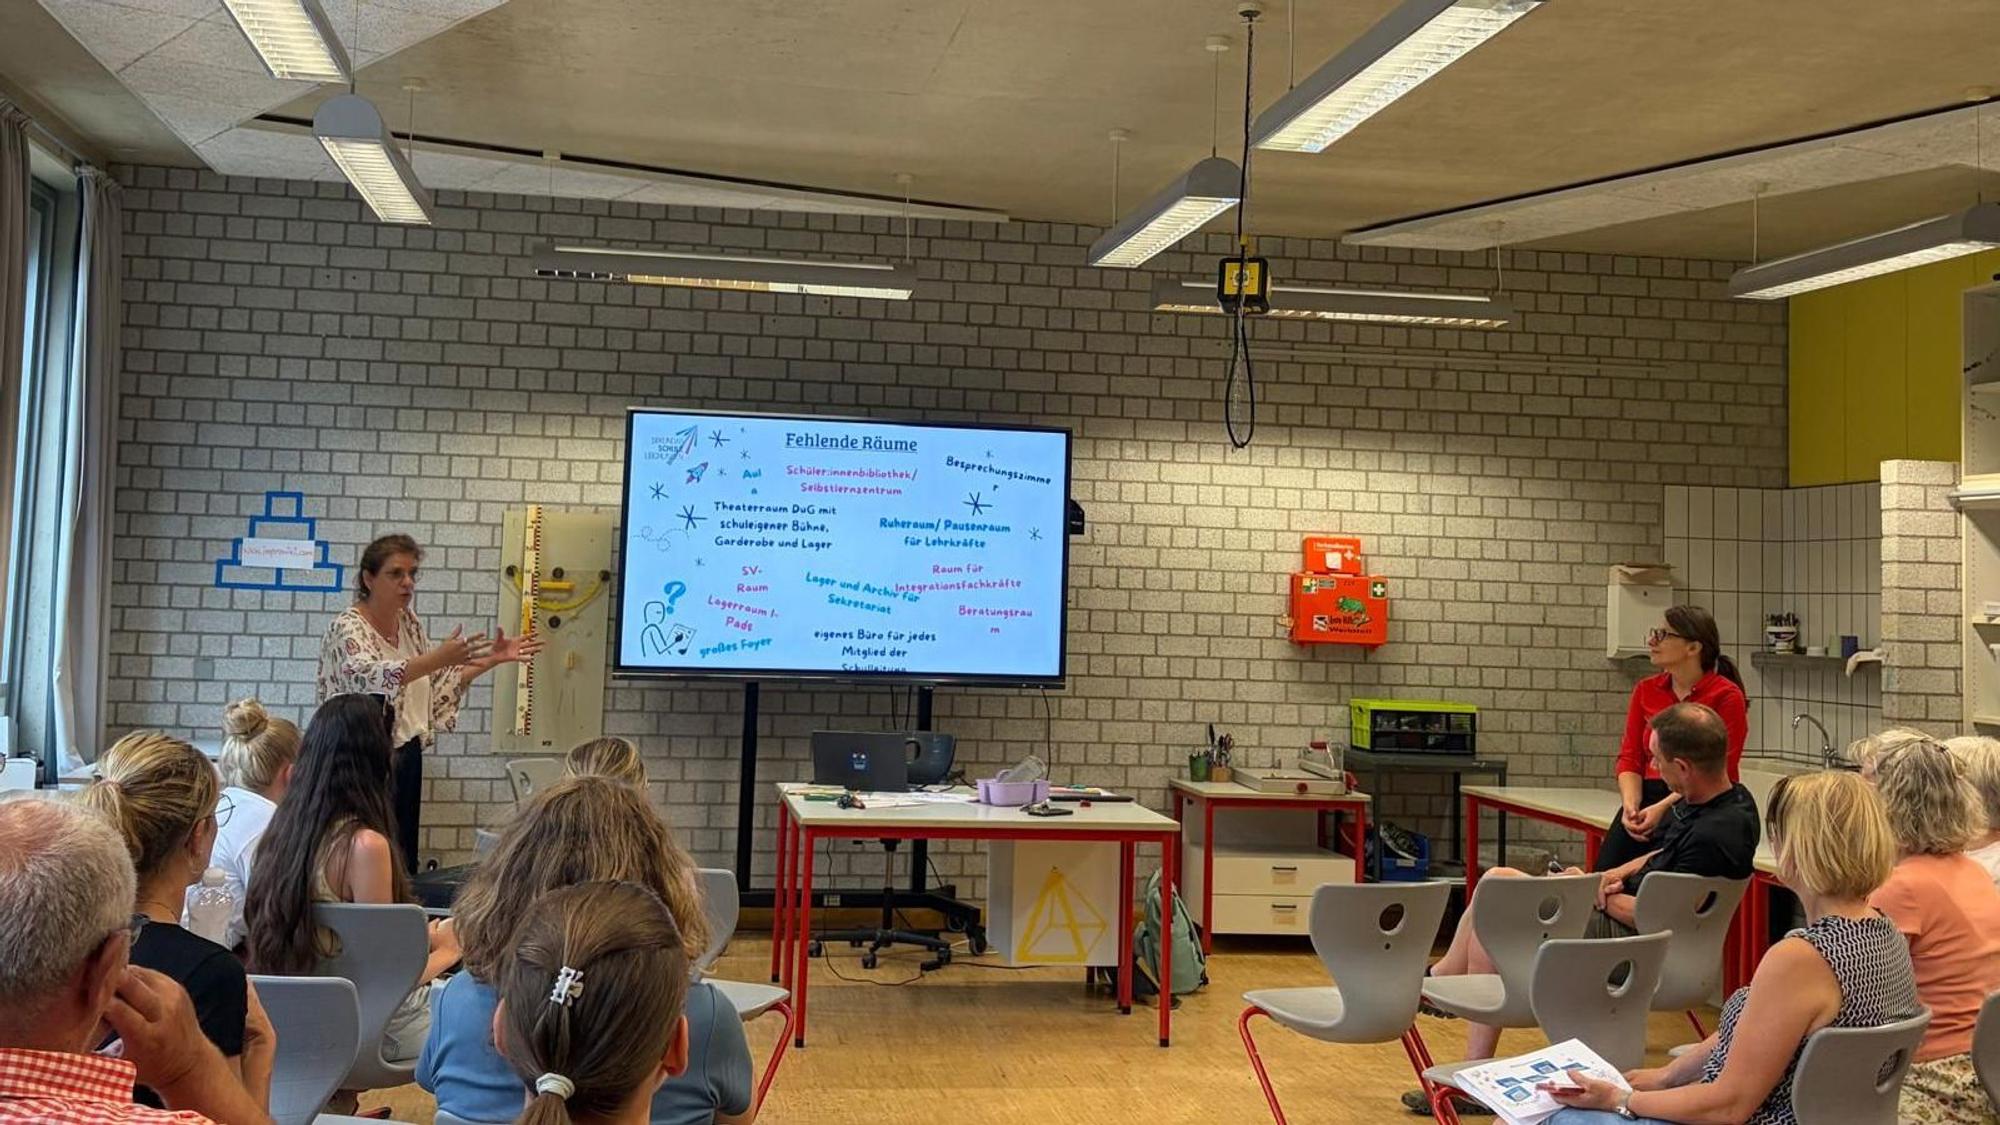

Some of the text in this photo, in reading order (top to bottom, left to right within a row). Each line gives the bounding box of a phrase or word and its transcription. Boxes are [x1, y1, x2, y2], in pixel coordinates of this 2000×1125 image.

[785, 432, 918, 452] Fehlende Räume
[742, 468, 762, 480] Aul
[946, 455, 1052, 486] Besprechungszimme
[800, 482, 902, 495] Selbstlernzentrum
[714, 501, 837, 515] Theaterraum DuG mit
[720, 519, 788, 533] schuleigener
[944, 519, 1011, 532] Pausenraum
[715, 535, 832, 552] Garderobe und Lager
[904, 535, 986, 549] für Lehrkräfte
[932, 563, 984, 575] Raum für
[736, 583, 769, 594] Raum
[806, 571, 921, 603] Lager und Archiv für
[895, 578, 1022, 594] Integrationsfachkräfte
[707, 594, 768, 617] Lagerraum
[828, 592, 892, 615] Sekretariat
[958, 605, 1034, 620] Beratungsrau
[726, 616, 753, 632] Pads
[814, 628, 937, 644] eigenes Büro für jedes
[700, 638, 773, 659] großes Foyer
[841, 645, 908, 660] Mitglied der
